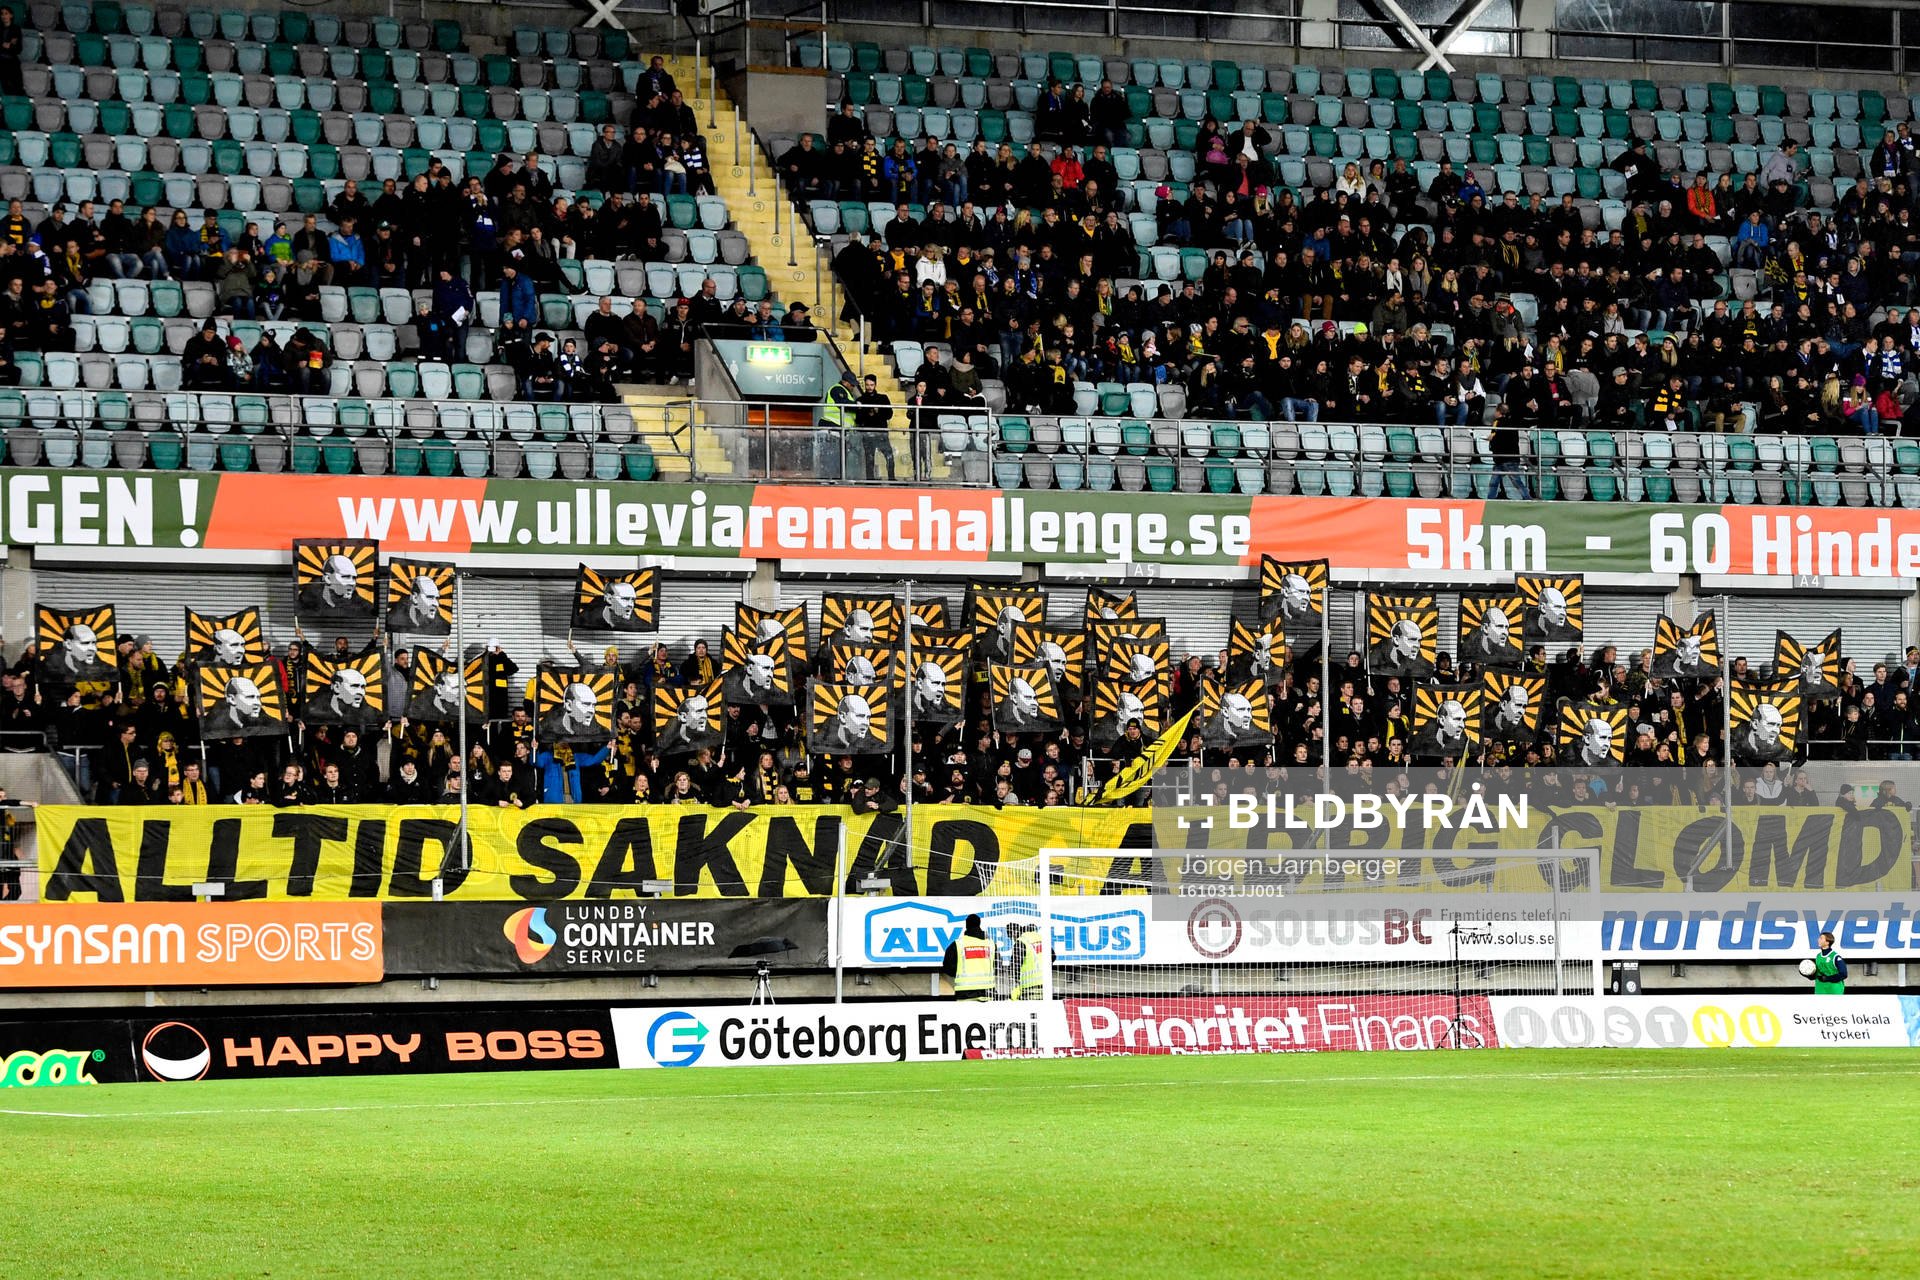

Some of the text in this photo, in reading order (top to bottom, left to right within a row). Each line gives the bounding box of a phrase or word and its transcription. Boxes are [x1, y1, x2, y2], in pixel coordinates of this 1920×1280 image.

[775, 374, 806, 385] KIOSK
[0, 474, 153, 546] GEN
[337, 487, 1250, 563] www.ulleviarenachallenge.se
[1406, 507, 1547, 572] 5km
[1585, 535, 1611, 550] -
[1649, 512, 1731, 574] 60
[44, 813, 473, 901] ALLTID
[509, 811, 1001, 899] SAKNAD
[565, 906, 647, 920] LUNDBY
[0, 922, 376, 965] SYNSAM SPORTS
[566, 949, 647, 964] SERVICE
[1459, 932, 1555, 945] www.solus.se
[719, 1012, 1039, 1061] Göteborg Energi
[1077, 1003, 1486, 1051] Prioritet Finans
[1793, 1013, 1890, 1027] Sveriges lokala
[1820, 1028, 1871, 1042] tryckeri
[223, 1029, 605, 1067] HAPPY BOSS
